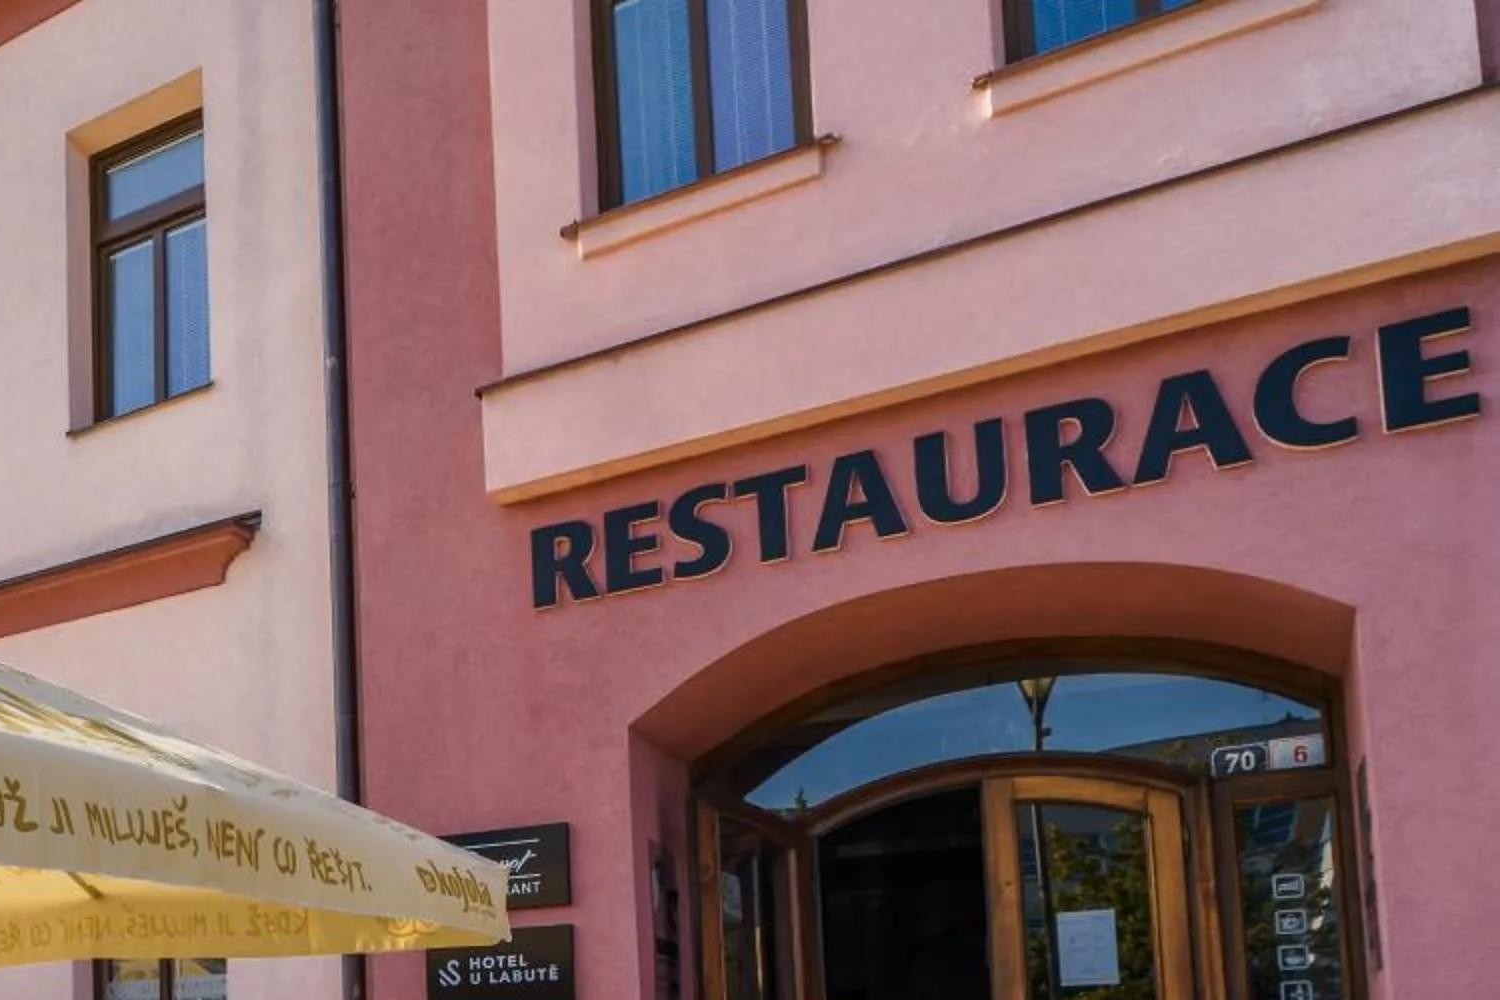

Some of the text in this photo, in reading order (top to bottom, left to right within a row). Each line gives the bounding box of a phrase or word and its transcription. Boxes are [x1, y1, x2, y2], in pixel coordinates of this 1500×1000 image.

[529, 305, 1481, 611] RESTAURACE
[1224, 749, 1256, 774] 70
[1293, 745, 1309, 765] 6
[49, 797, 75, 836] JI
[84, 794, 199, 858] MILUJEŠ,
[205, 817, 266, 873] NENÍ
[273, 836, 298, 877] CO
[303, 834, 373, 893] ŘEŠIT.
[469, 953, 528, 971] HOTEL
[469, 962, 560, 986] U LABUTĚ
